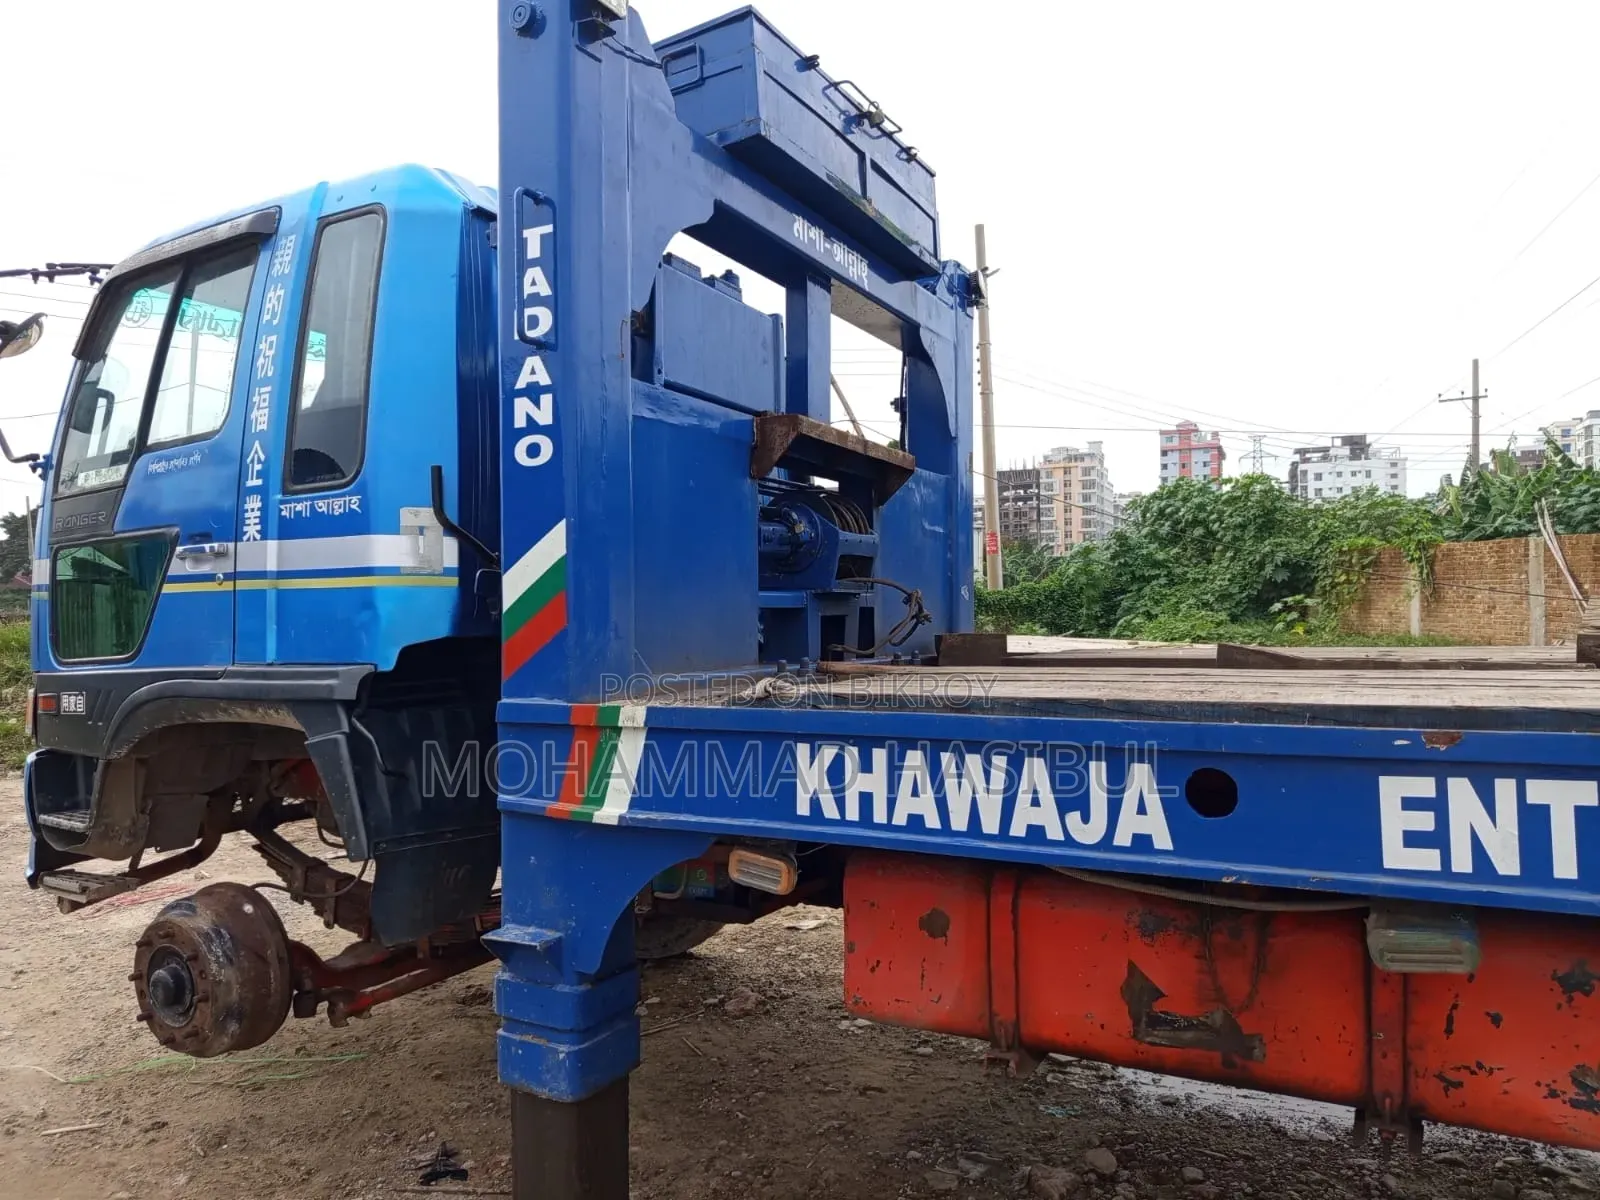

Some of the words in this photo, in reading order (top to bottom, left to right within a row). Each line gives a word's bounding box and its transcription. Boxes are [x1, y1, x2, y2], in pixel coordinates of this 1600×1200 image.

[513, 223, 554, 467] TADANO
[55, 511, 106, 531] RANGER
[279, 500, 312, 519] মাশা
[314, 495, 362, 516] আল্লাহ
[796, 742, 1174, 851] KHAWAJA
[1379, 775, 1599, 880] ENT
